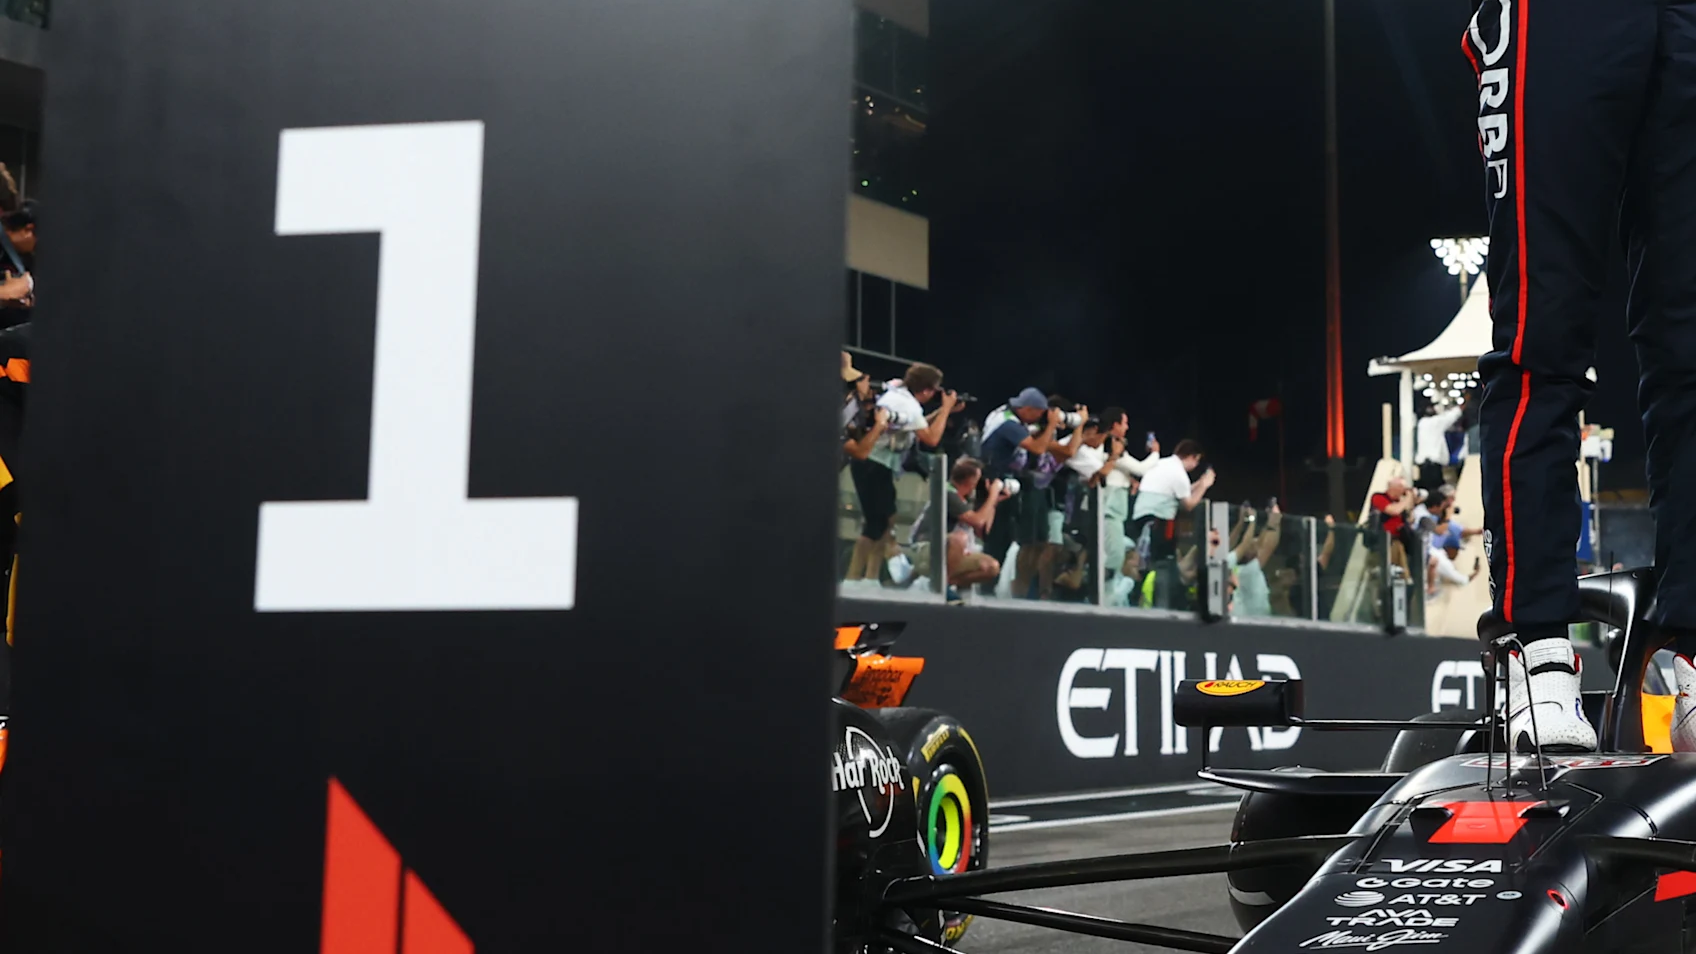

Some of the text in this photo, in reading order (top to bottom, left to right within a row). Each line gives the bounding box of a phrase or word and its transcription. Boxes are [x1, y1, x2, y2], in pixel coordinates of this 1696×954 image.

[254, 120, 579, 612] 1
[1381, 859, 1502, 873] VISA
[1391, 878, 1494, 888] Gate
[1388, 894, 1487, 905] AT&T
[1358, 909, 1433, 918] AVA
[1326, 917, 1460, 927] TRADE
